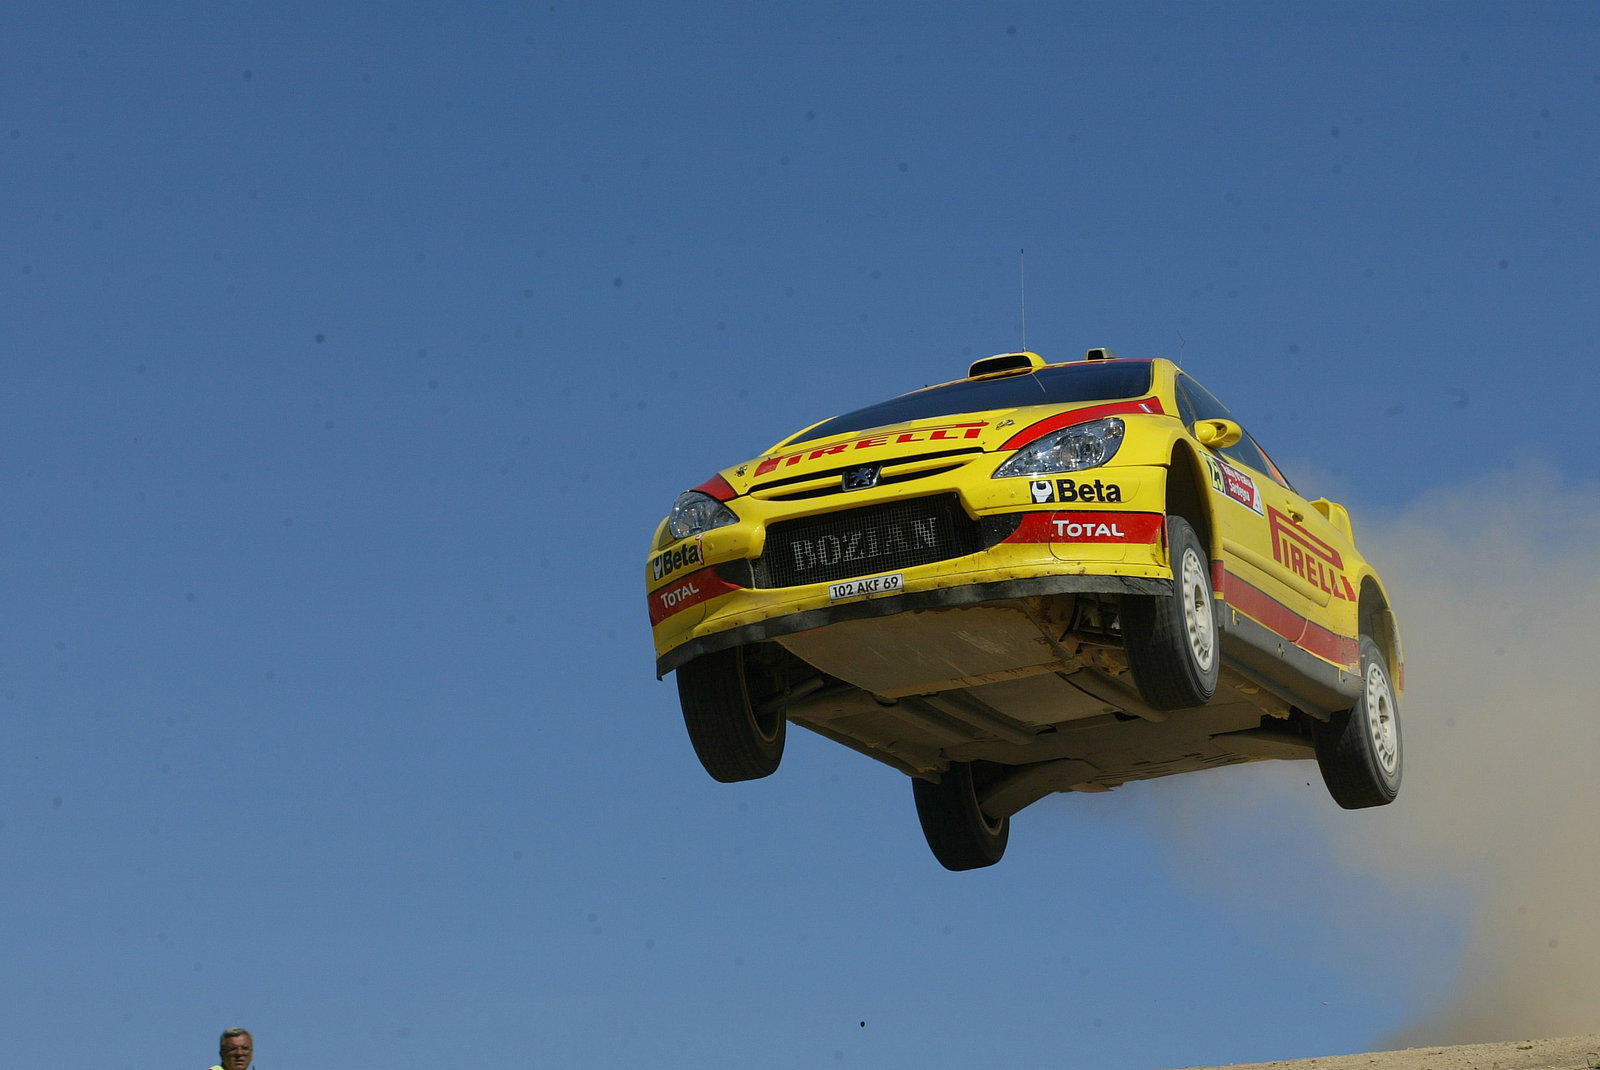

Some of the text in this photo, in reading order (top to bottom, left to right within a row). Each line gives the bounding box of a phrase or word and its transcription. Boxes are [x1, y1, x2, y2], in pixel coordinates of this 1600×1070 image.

[754, 421, 989, 477] PIRELLI
[1056, 479, 1121, 502] Beta
[1053, 520, 1124, 537] TOTAL
[791, 517, 936, 571] BOZIAN
[1266, 504, 1356, 602] PIRELLI
[662, 543, 700, 575] Beta
[661, 582, 699, 608] TOTAL
[832, 576, 899, 598] 102 AKF 69
